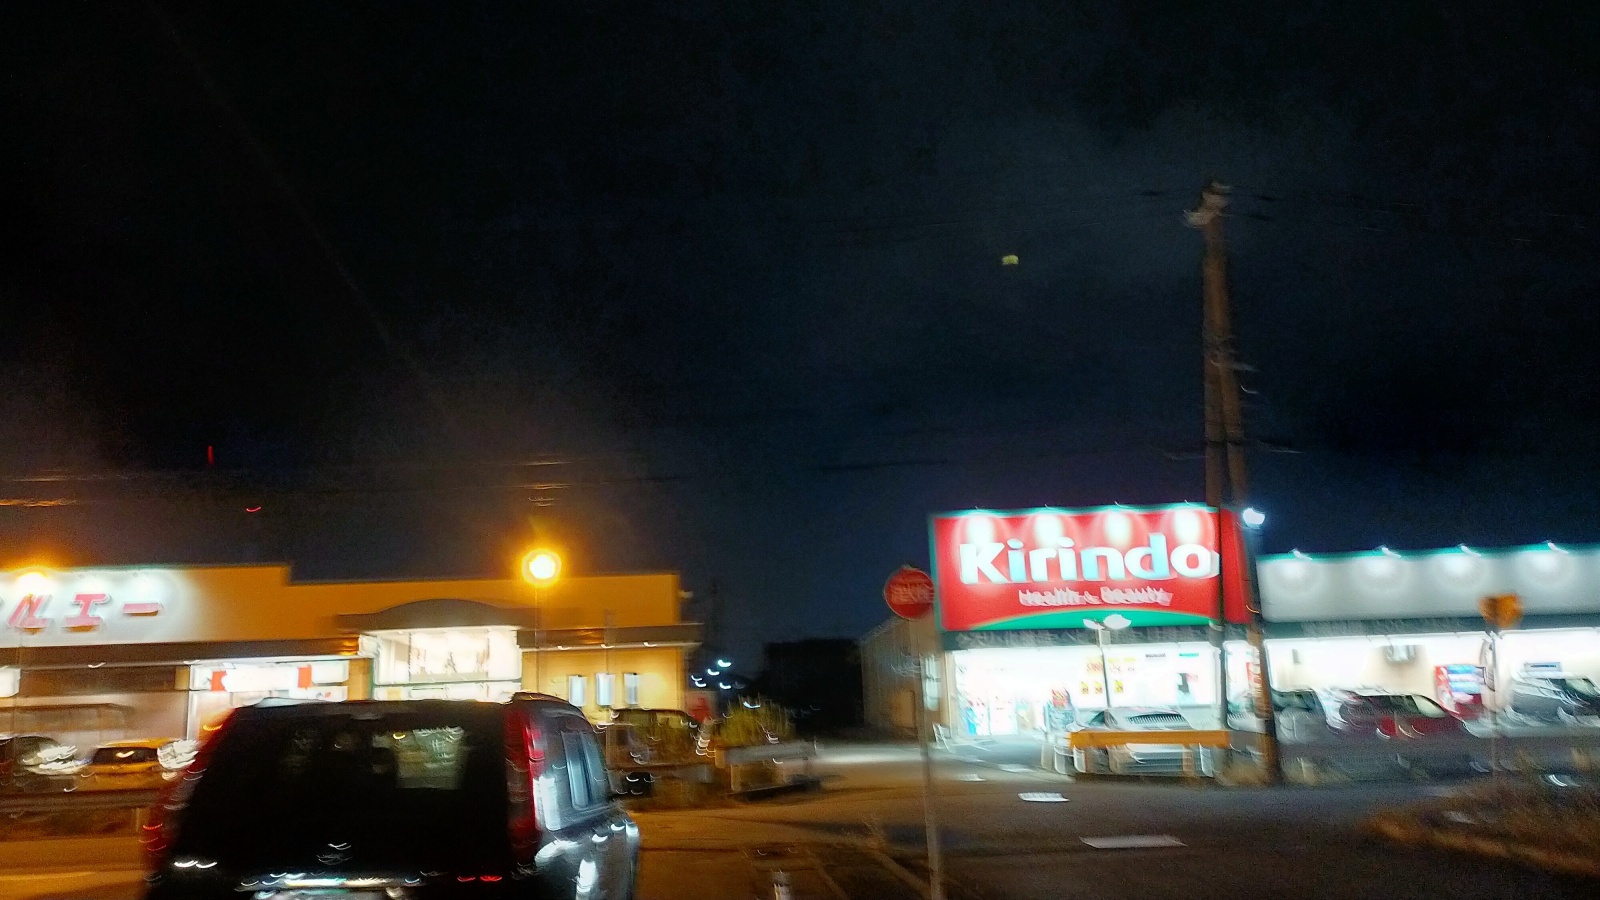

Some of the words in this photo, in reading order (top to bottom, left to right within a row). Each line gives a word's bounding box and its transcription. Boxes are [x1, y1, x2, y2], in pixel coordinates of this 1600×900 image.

[959, 533, 1220, 584] Kirindo
[1018, 587, 1086, 606] Health
[1100, 586, 1174, 606] Beauty
